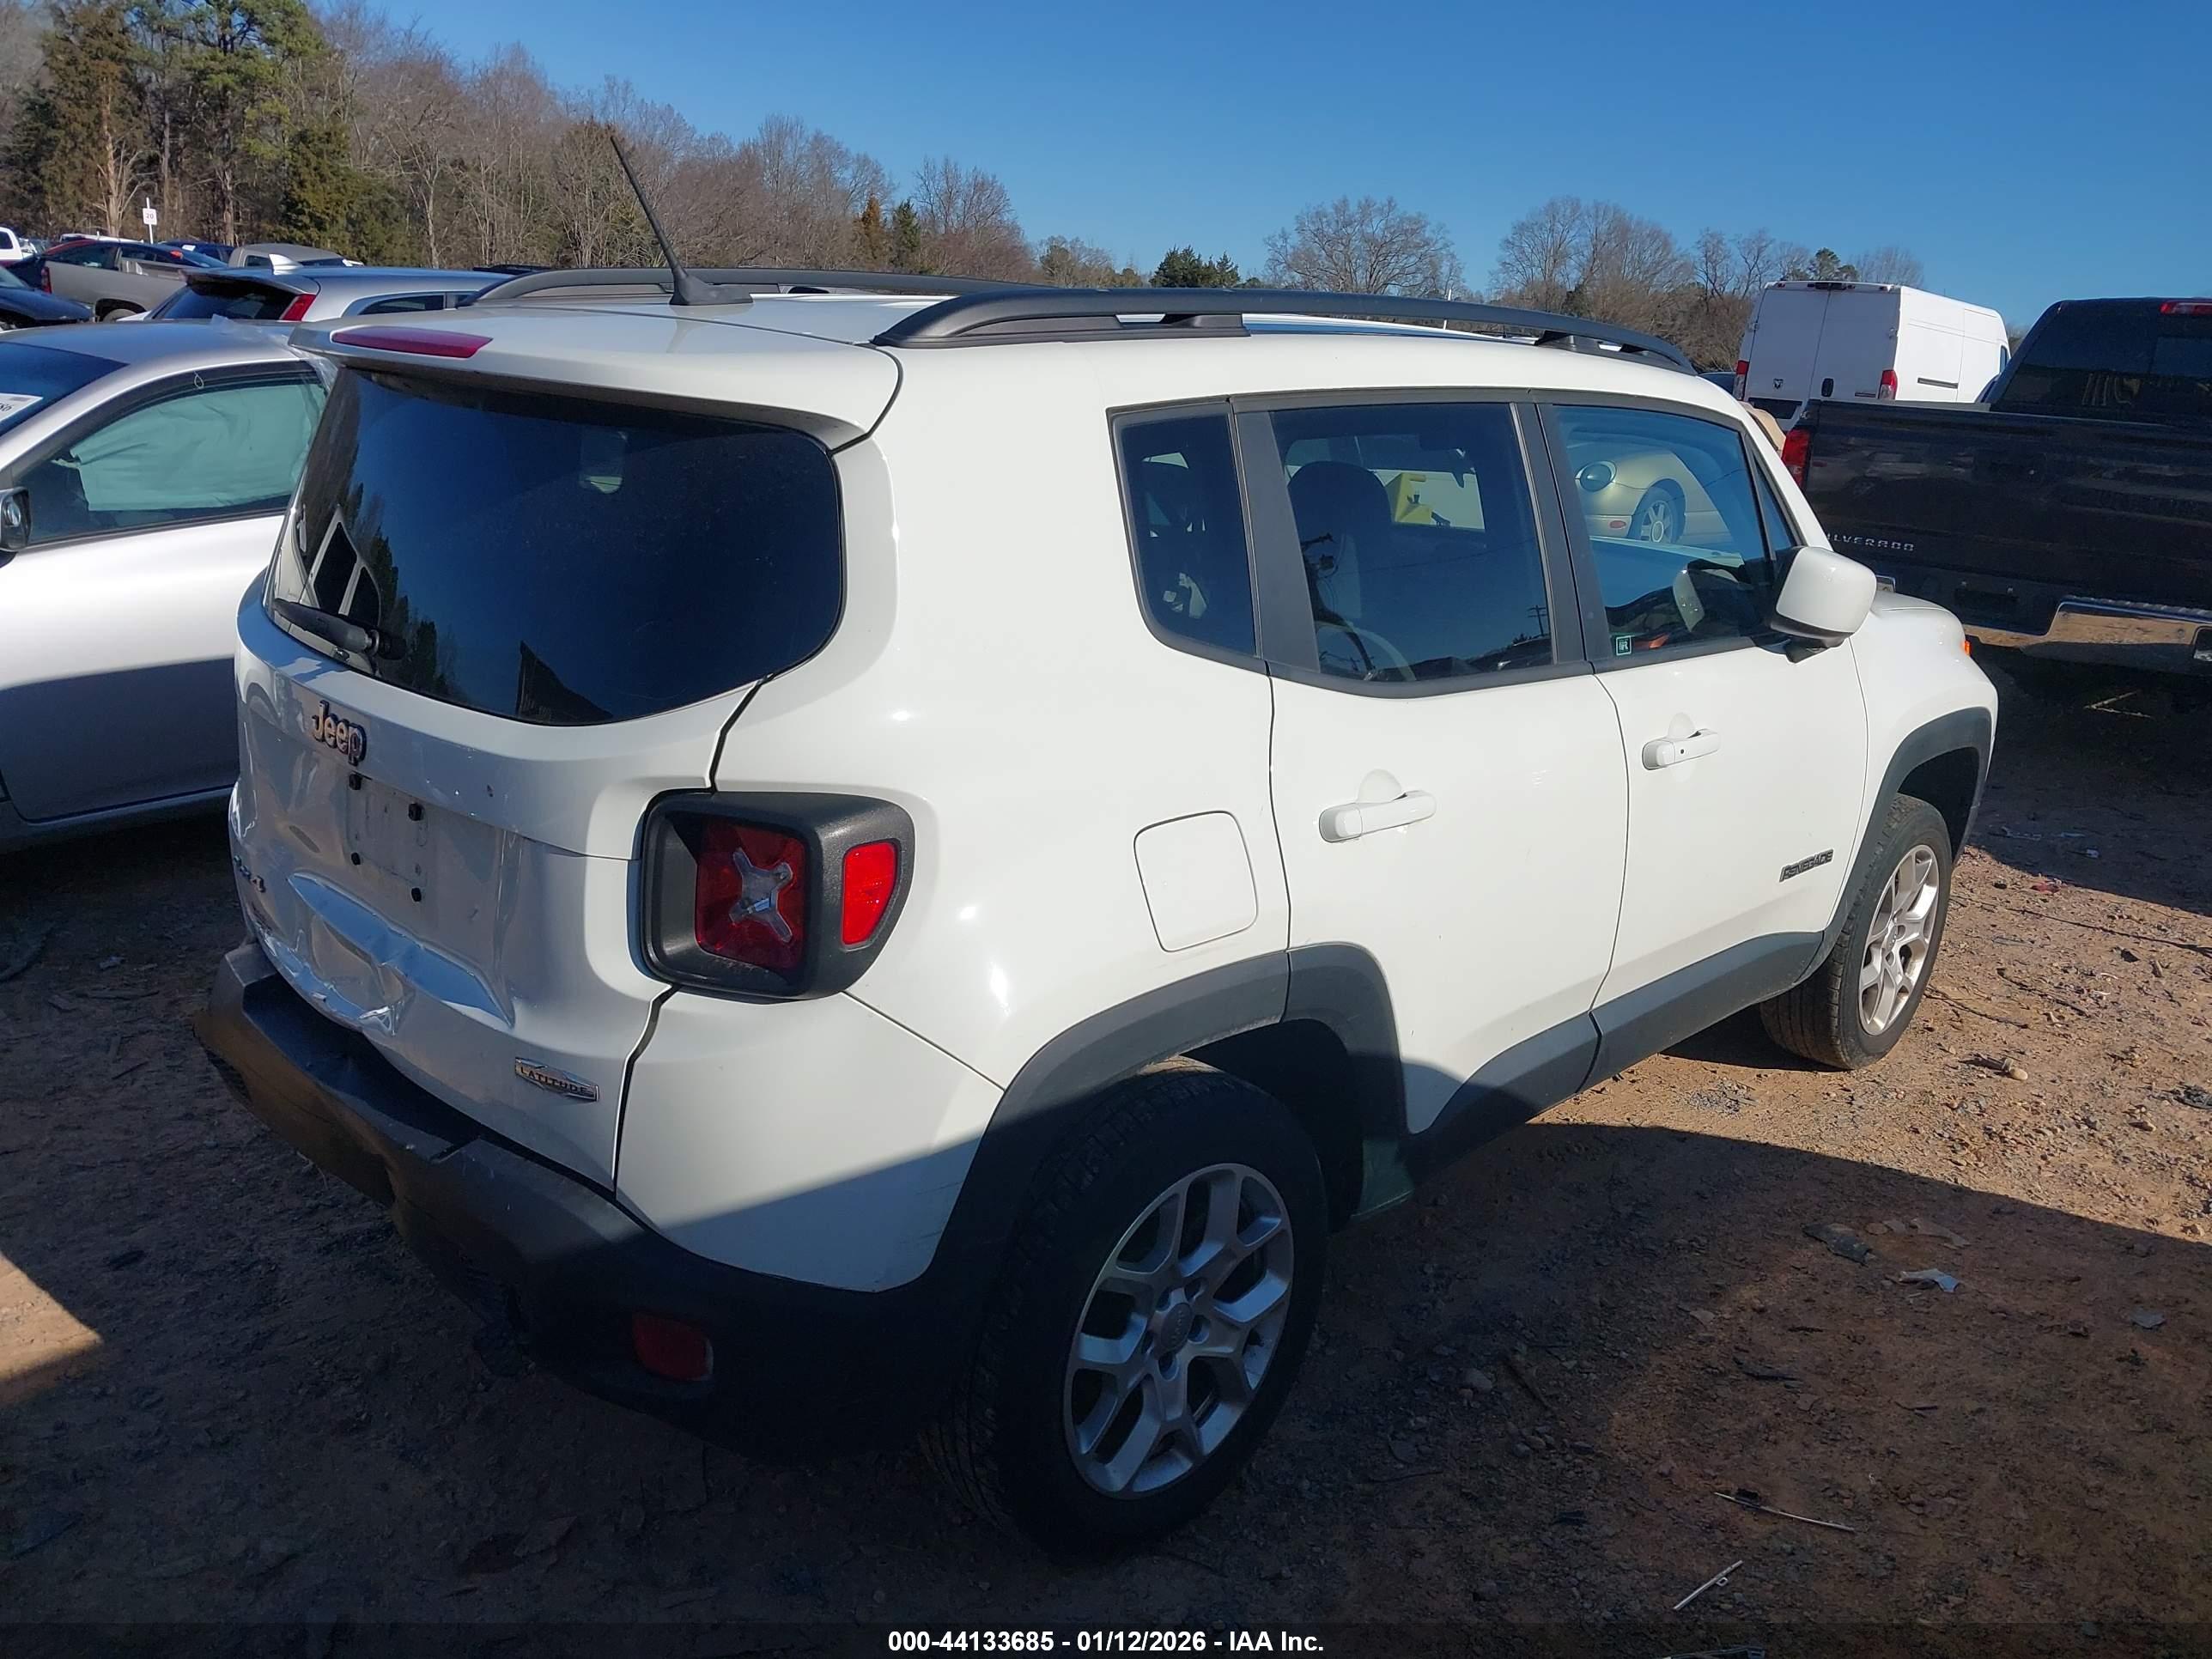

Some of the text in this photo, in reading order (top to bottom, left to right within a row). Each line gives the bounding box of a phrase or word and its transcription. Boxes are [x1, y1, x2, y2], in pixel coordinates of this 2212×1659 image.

[1826, 533, 1914, 551] ILVERADO
[312, 699, 367, 766] Jeep
[1779, 848, 1833, 883] RENEGADE
[520, 1066, 590, 1095] LATITUDE
